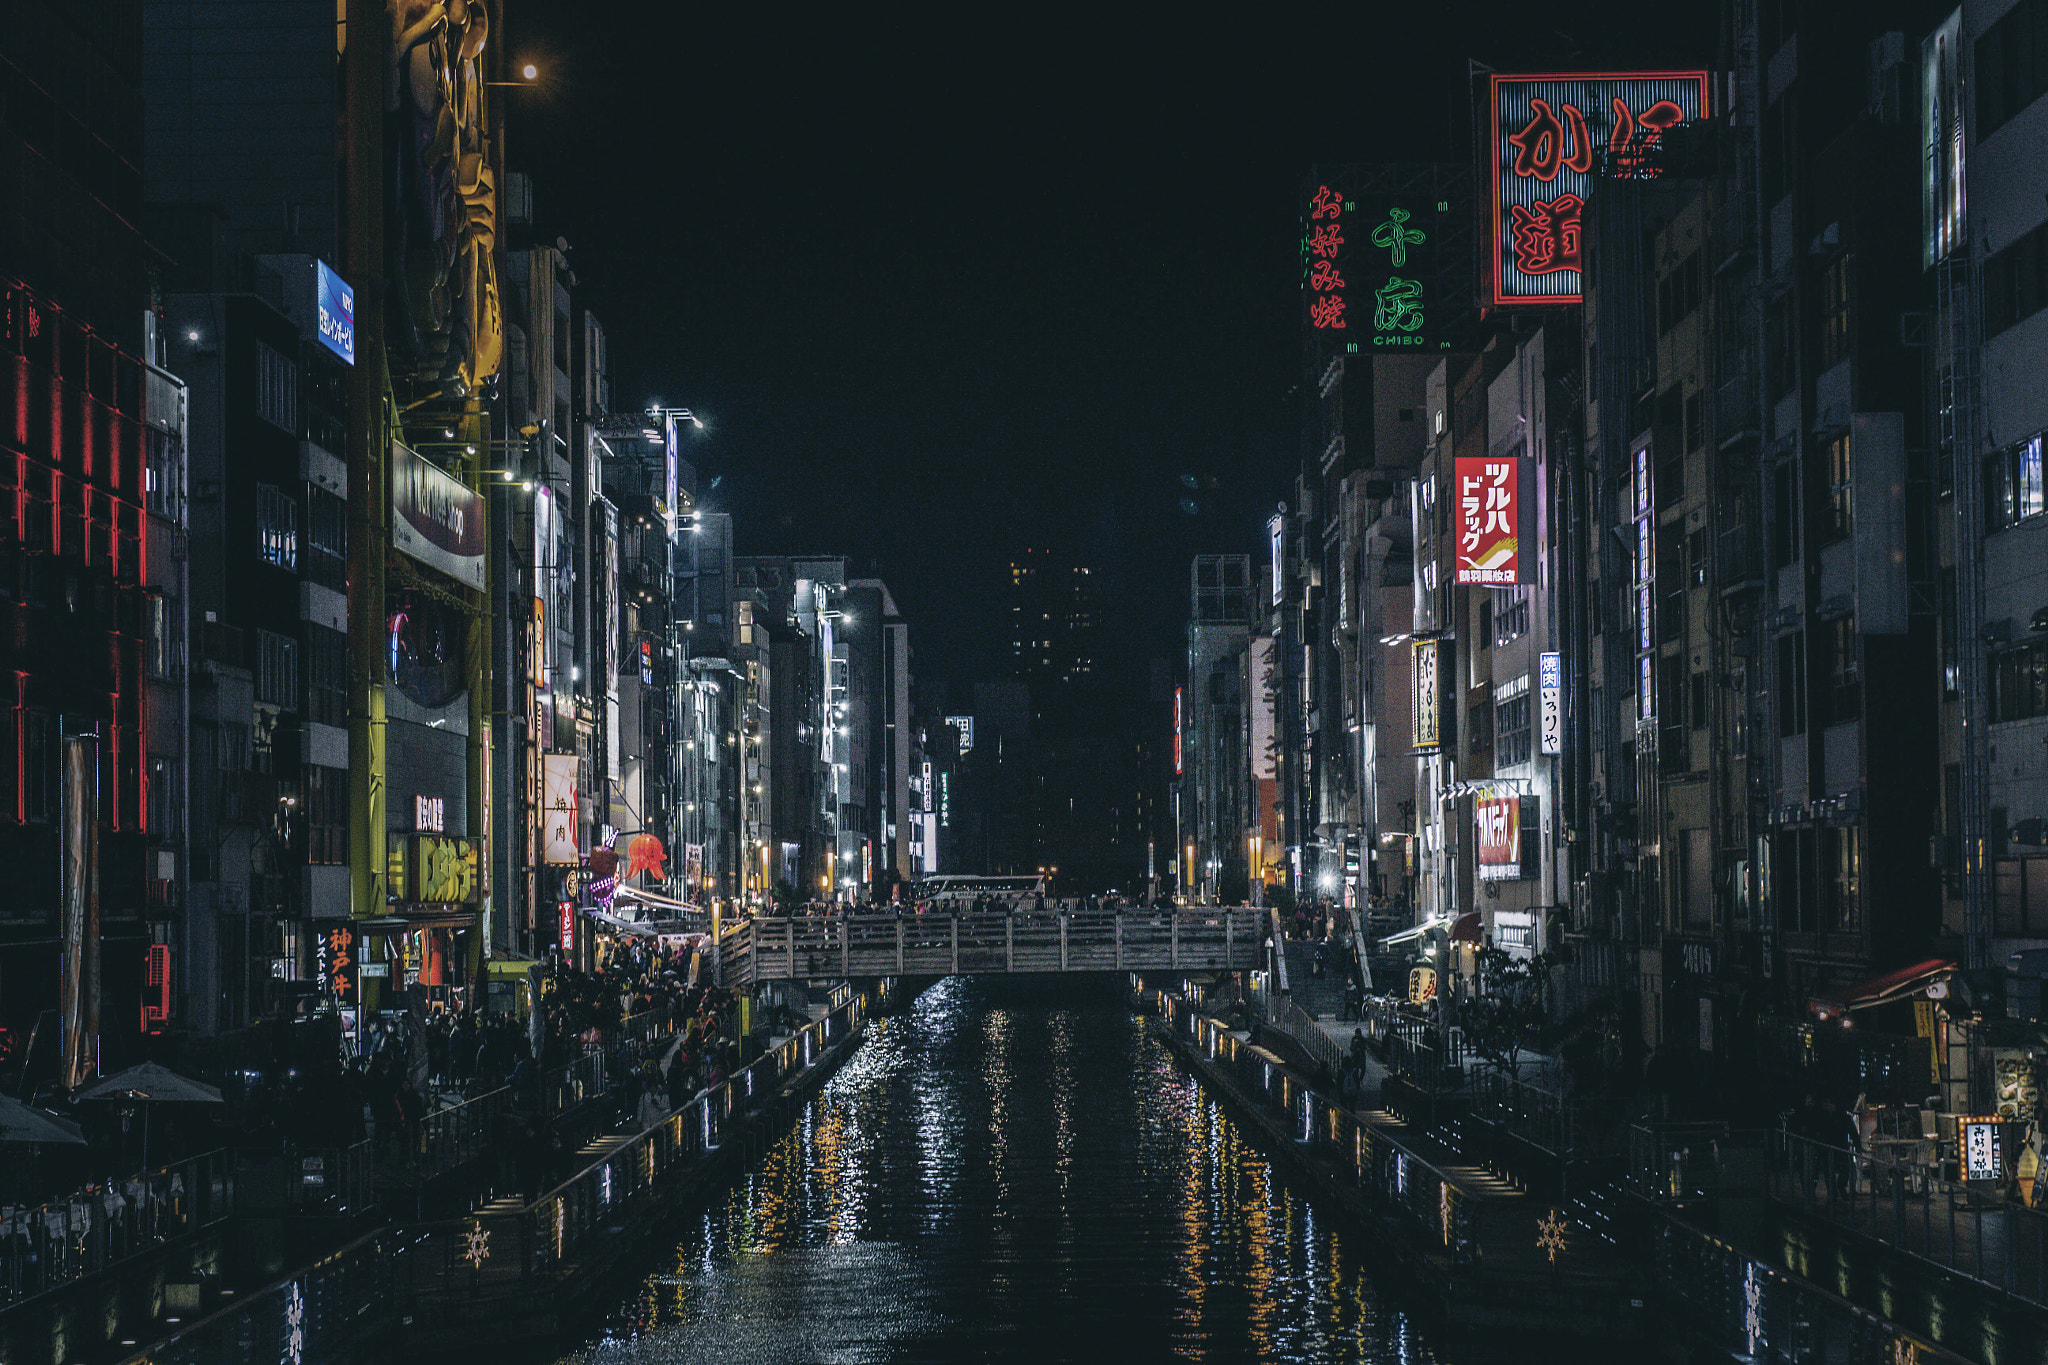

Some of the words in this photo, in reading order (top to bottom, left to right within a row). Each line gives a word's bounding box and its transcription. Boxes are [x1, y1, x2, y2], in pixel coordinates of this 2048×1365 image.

[1310, 185, 1347, 329] お好み焼
[1371, 207, 1426, 332] 千房
[1373, 335, 1425, 346] CHIBO
[1462, 476, 1484, 553] ドラッグ
[1485, 464, 1511, 534] ツルハ
[1542, 691, 1558, 751] いろりや
[554, 793, 568, 842] 焼肉
[330, 927, 352, 997] 神戸牛
